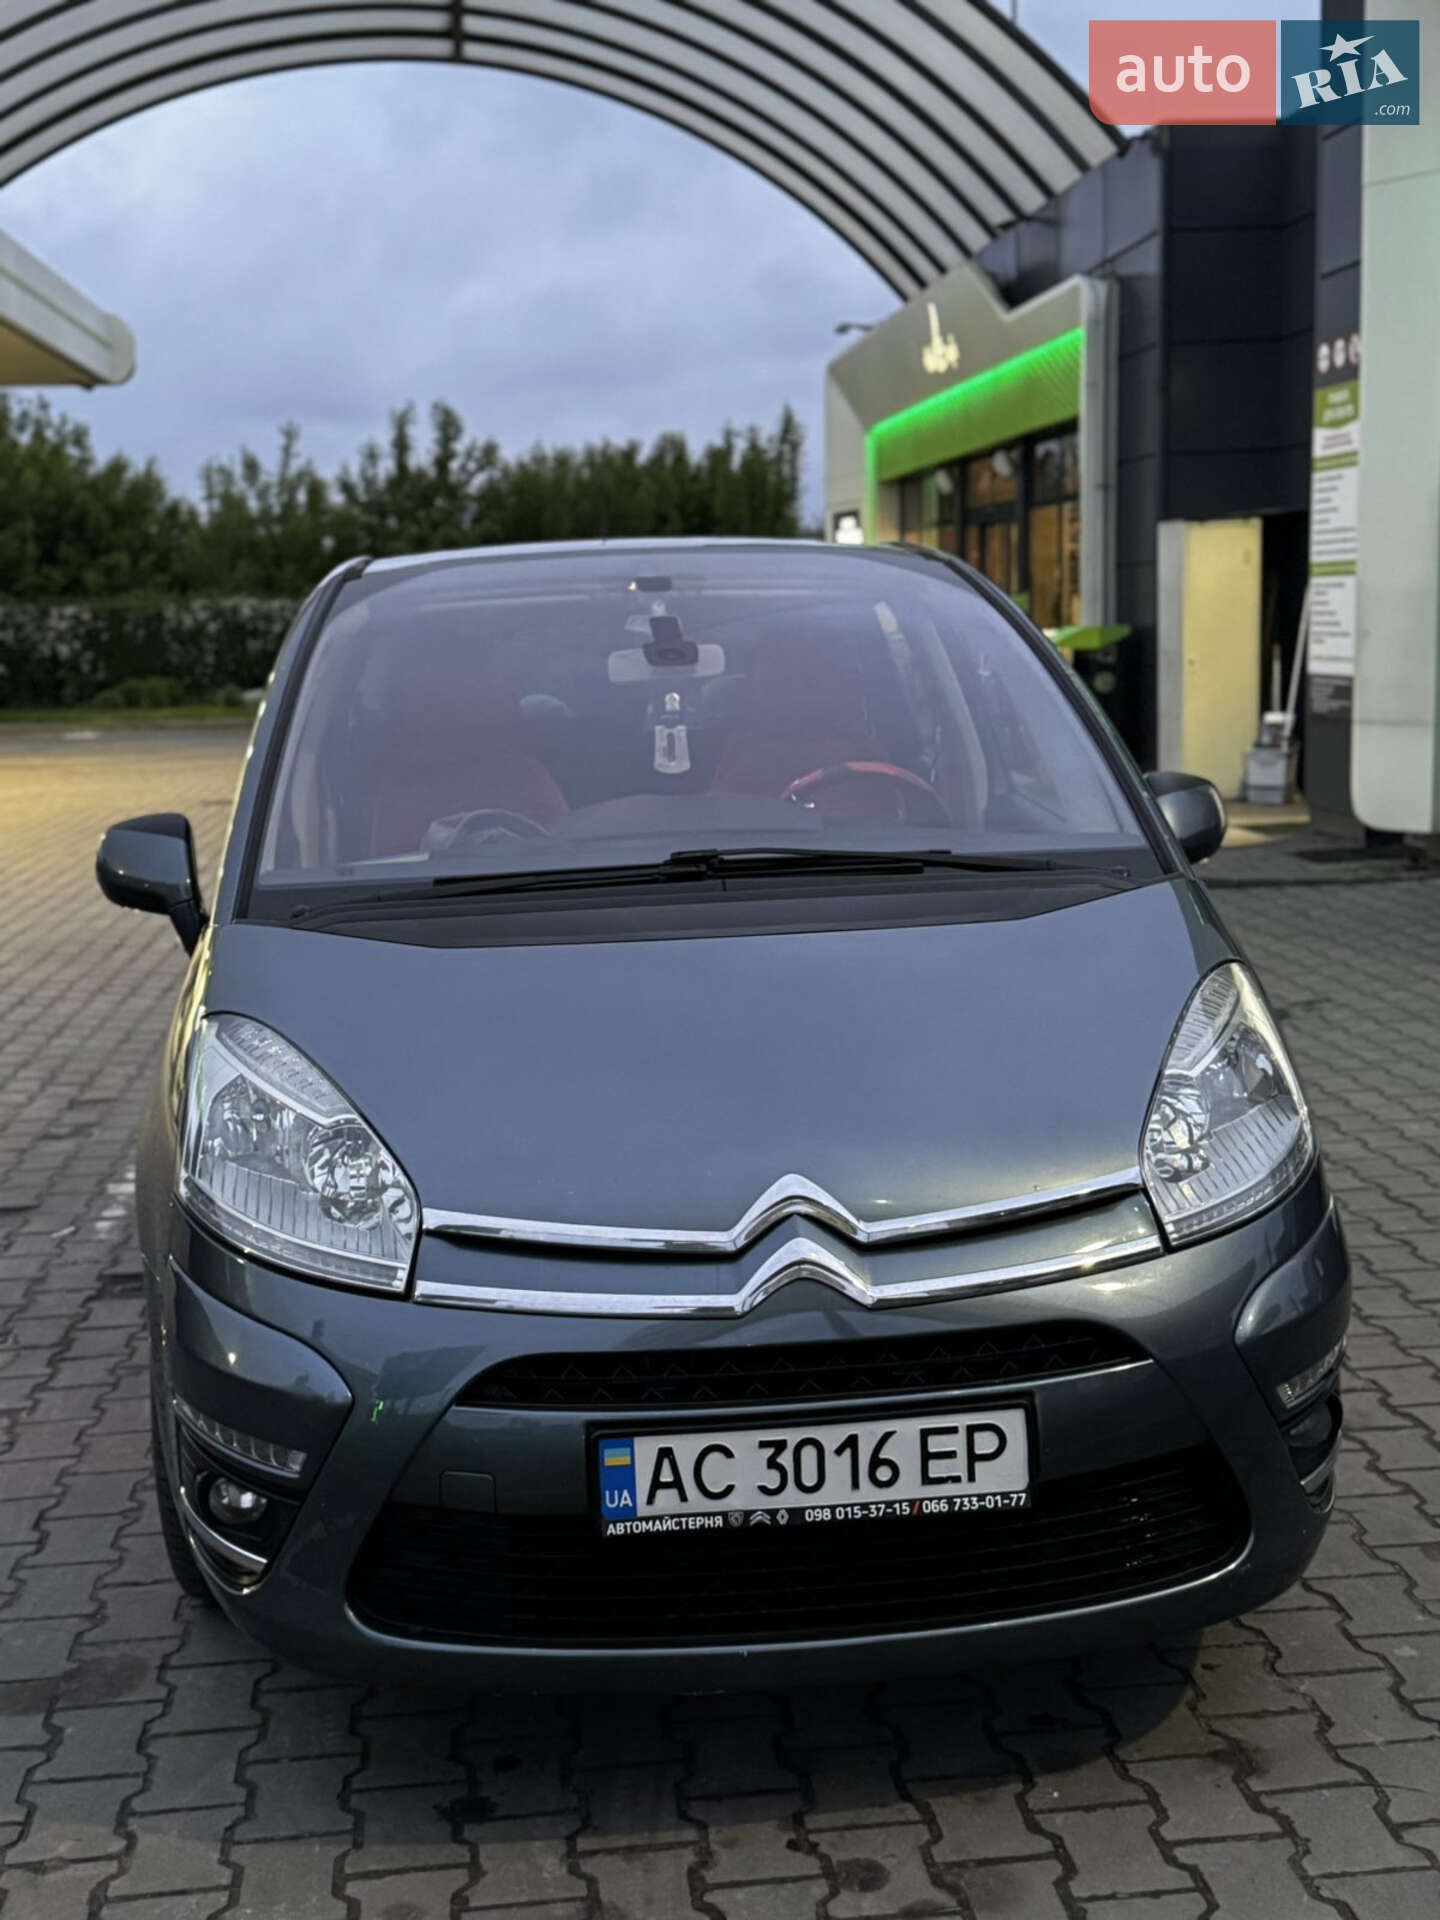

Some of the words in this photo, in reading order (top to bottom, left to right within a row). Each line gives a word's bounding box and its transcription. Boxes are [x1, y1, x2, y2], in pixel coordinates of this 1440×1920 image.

[645, 1443, 736, 1507] AC
[756, 1430, 900, 1497] 3016
[919, 1422, 1008, 1487] EP
[605, 1489, 633, 1509] UA
[804, 1507, 832, 1522] 098
[952, 1492, 1027, 1511] 733-01-77
[606, 1515, 724, 1537] АВТОМАЙСТЕРНЯ
